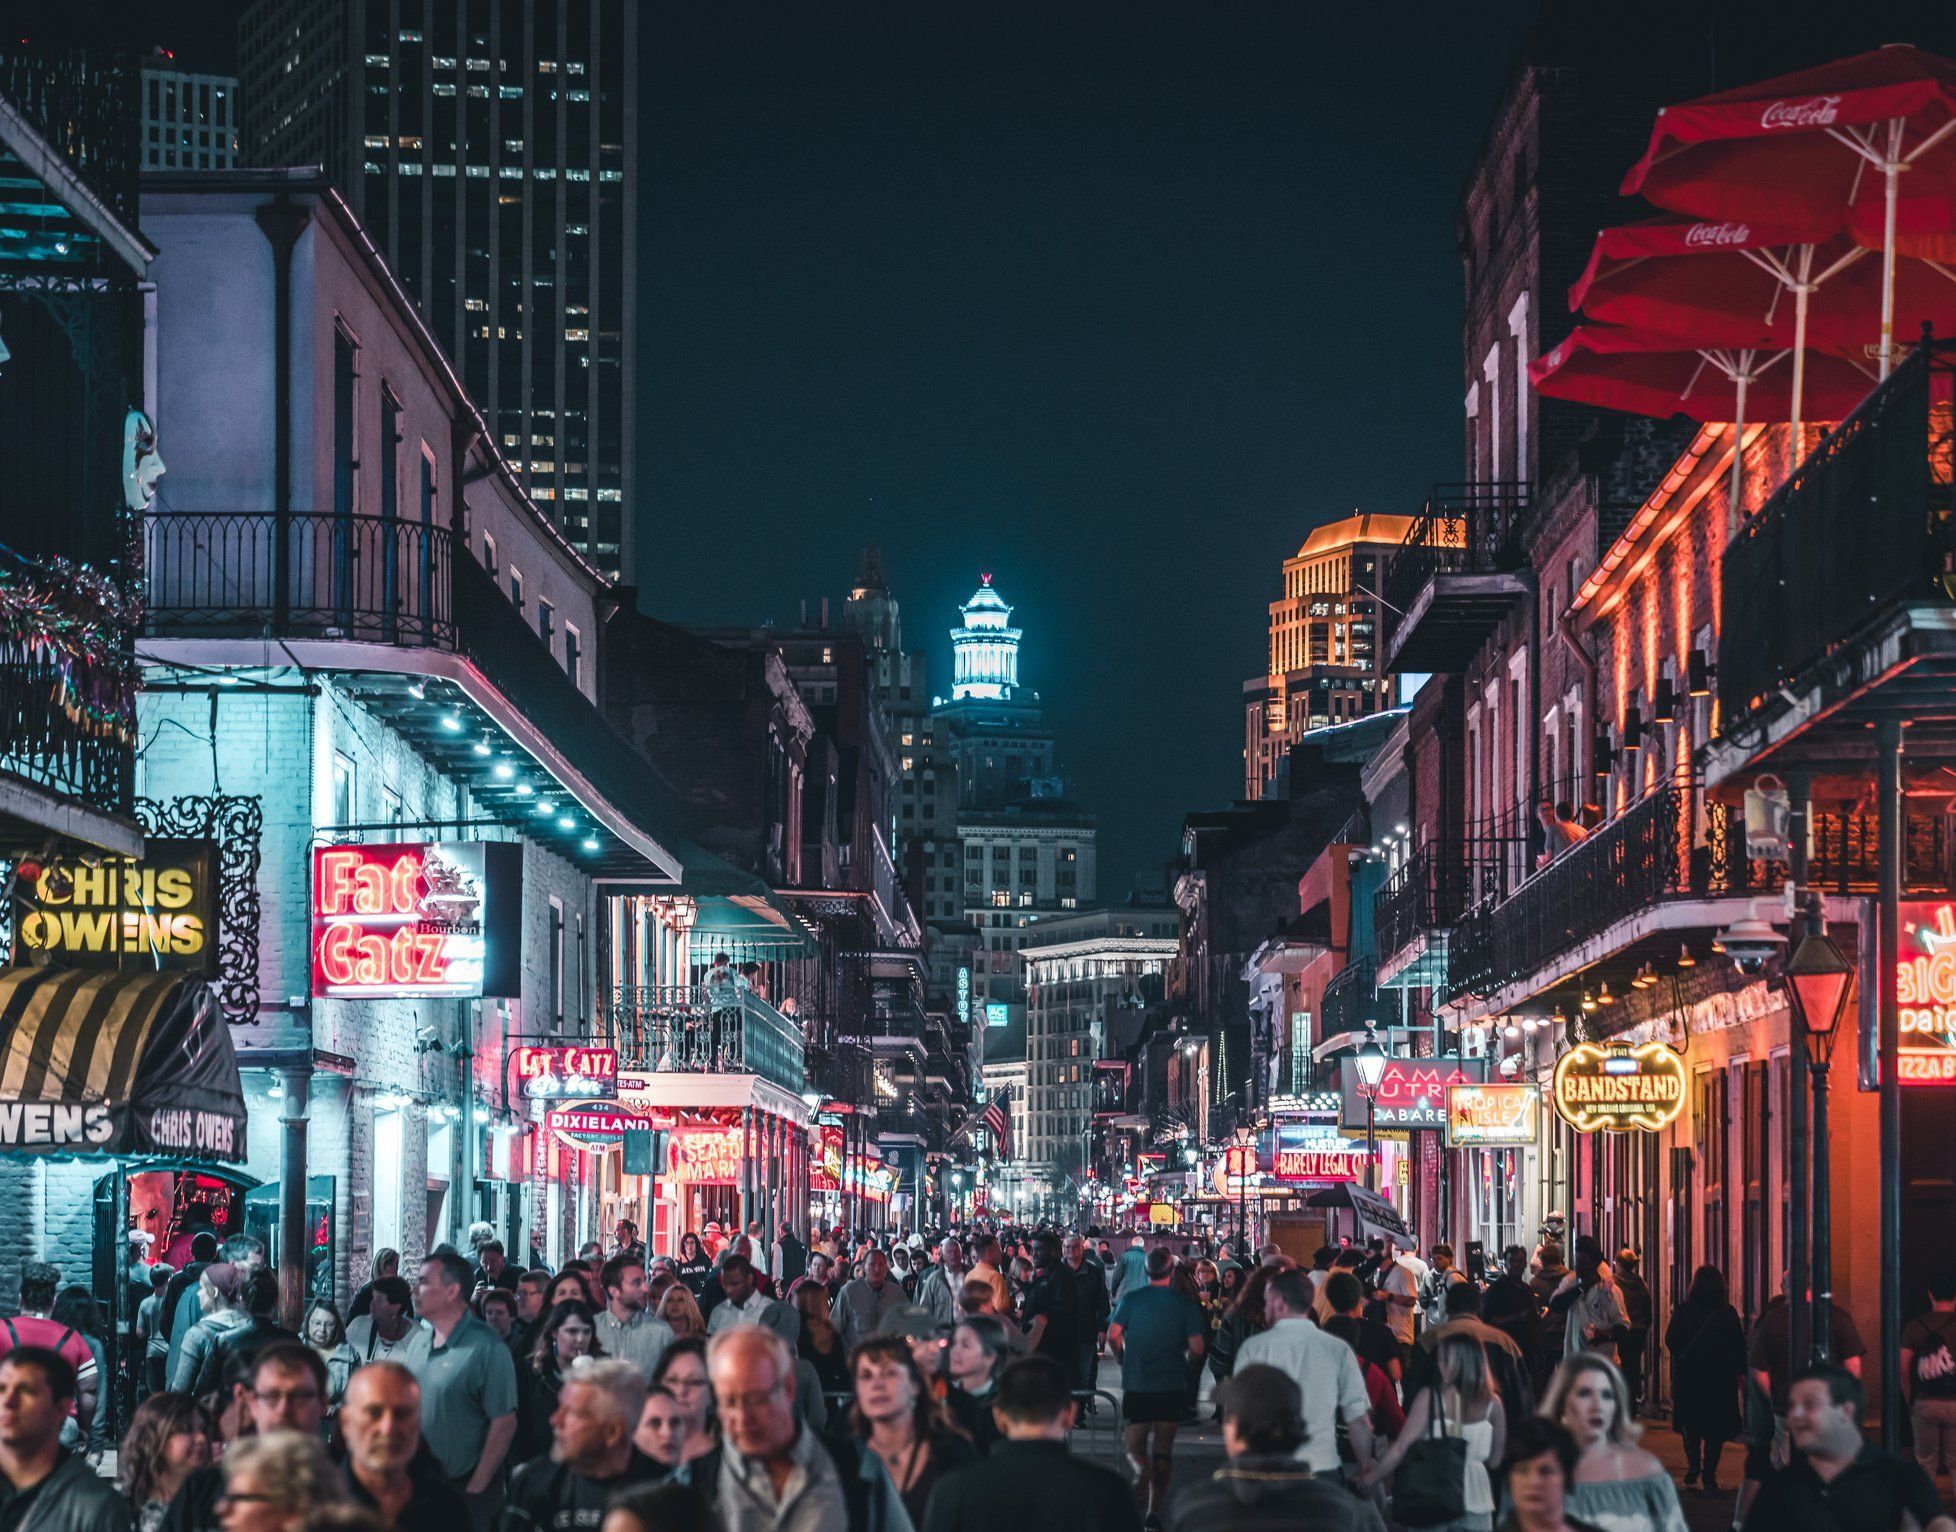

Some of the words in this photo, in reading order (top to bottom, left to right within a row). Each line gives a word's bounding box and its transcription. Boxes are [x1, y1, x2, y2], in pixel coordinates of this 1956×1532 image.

[36, 866, 193, 908] CHRIS
[321, 852, 419, 914] Fat
[21, 911, 203, 954] OWENS
[321, 922, 449, 984] Catz
[958, 967, 969, 1023] ASTOR
[519, 1048, 554, 1077] FAT
[563, 1048, 614, 1077] CATZ
[1898, 1056, 1941, 1078] IZZA
[1384, 1067, 1469, 1082] AMA
[1356, 1083, 1443, 1098] SUTR
[1564, 1075, 1680, 1102] BANDSTAND
[1456, 1096, 1521, 1110] TROPICA
[1585, 1104, 1597, 1113] NEW
[0, 1105, 114, 1143] WENS
[551, 1113, 650, 1130] DIXIELAND
[1374, 1109, 1447, 1121] CABARE
[1477, 1110, 1510, 1124] ISLE
[151, 1108, 192, 1147] CHRIS
[196, 1112, 235, 1152] OWENS
[570, 1132, 599, 1140] FACTORY
[590, 1145, 606, 1153] ATM
[1279, 1153, 1317, 1176] BARELY
[1320, 1152, 1350, 1176] LEGAL
